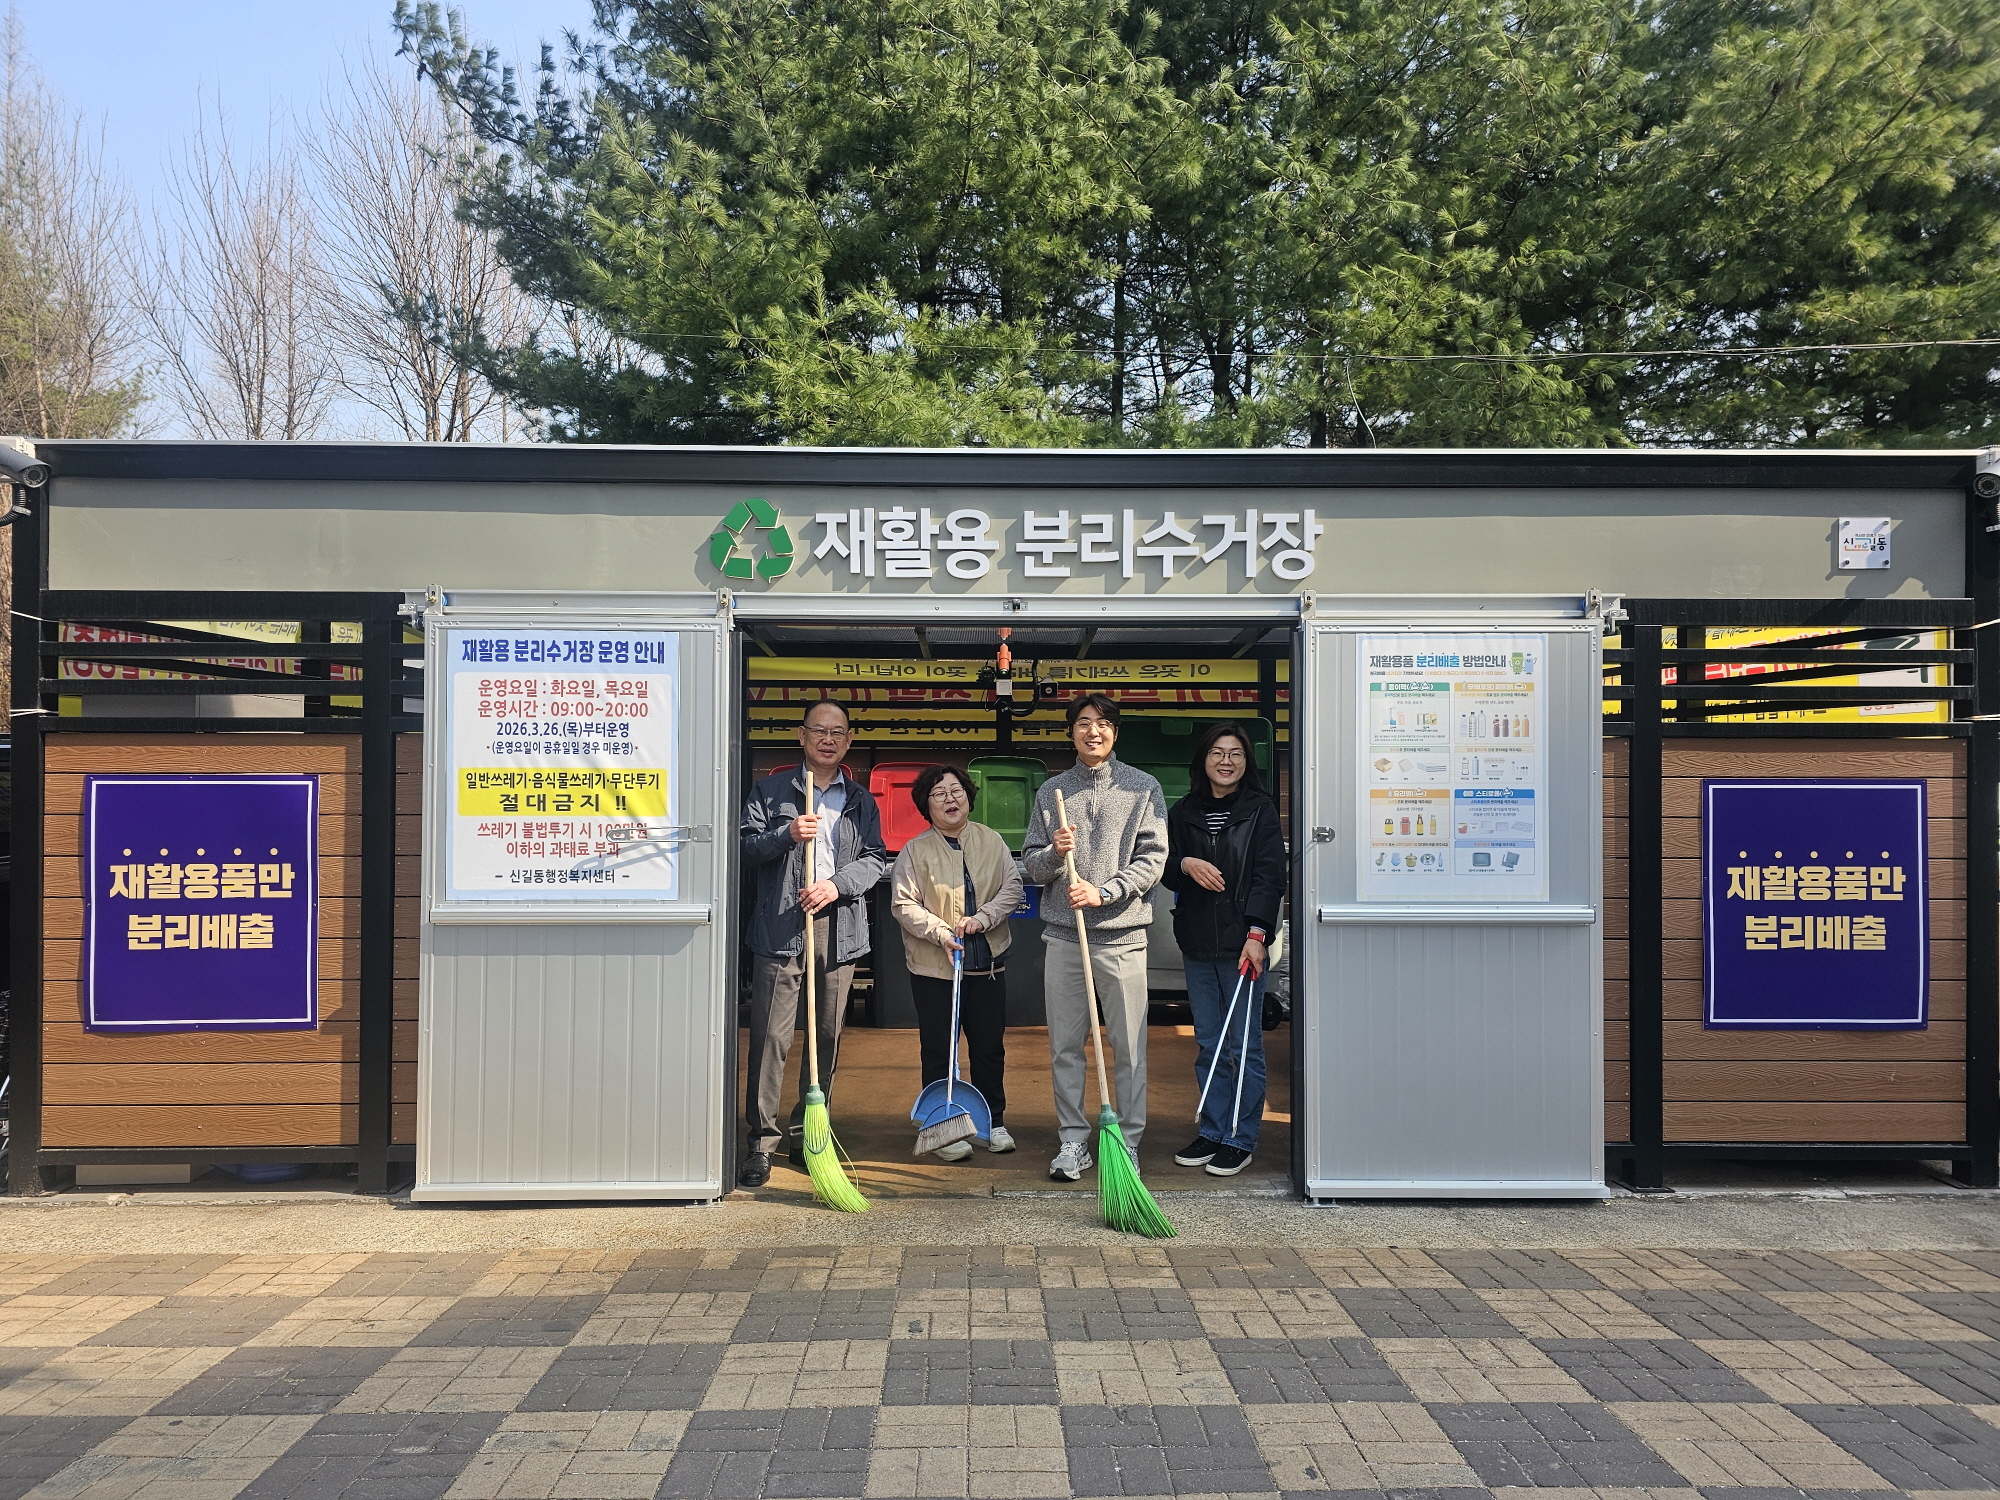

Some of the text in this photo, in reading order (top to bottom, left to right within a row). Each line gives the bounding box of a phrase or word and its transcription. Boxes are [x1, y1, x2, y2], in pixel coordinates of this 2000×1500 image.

[814, 506, 1324, 581] 재활용 분리수거장
[461, 639, 665, 664] 재활용 분리수거장 운영 안내
[1370, 655, 1506, 668] 재활용품 분리배출 방법안내
[477, 679, 538, 698] 운영요일
[550, 679, 601, 699] 화요일,
[604, 680, 649, 699] 목요일
[477, 699, 538, 718] 운영시간
[550, 702, 649, 718] 09:00~20:00
[496, 722, 630, 738] 2026.3.26.(목)부터운영
[491, 741, 634, 755] (운영요일이 공휴일일 경우 미운영)
[615, 795, 627, 811] !!
[477, 822, 517, 839] 쓰레기
[521, 822, 575, 839] 불법투기
[579, 822, 592, 838] 시
[506, 841, 621, 858] 이하의 과태료 부과
[109, 863, 296, 899] 재활용품만
[509, 869, 616, 884] 신길동행정복지센터
[1727, 866, 1907, 901] 재활용품만
[127, 913, 275, 950] 분리배출
[1744, 915, 1887, 950] 분리배출
